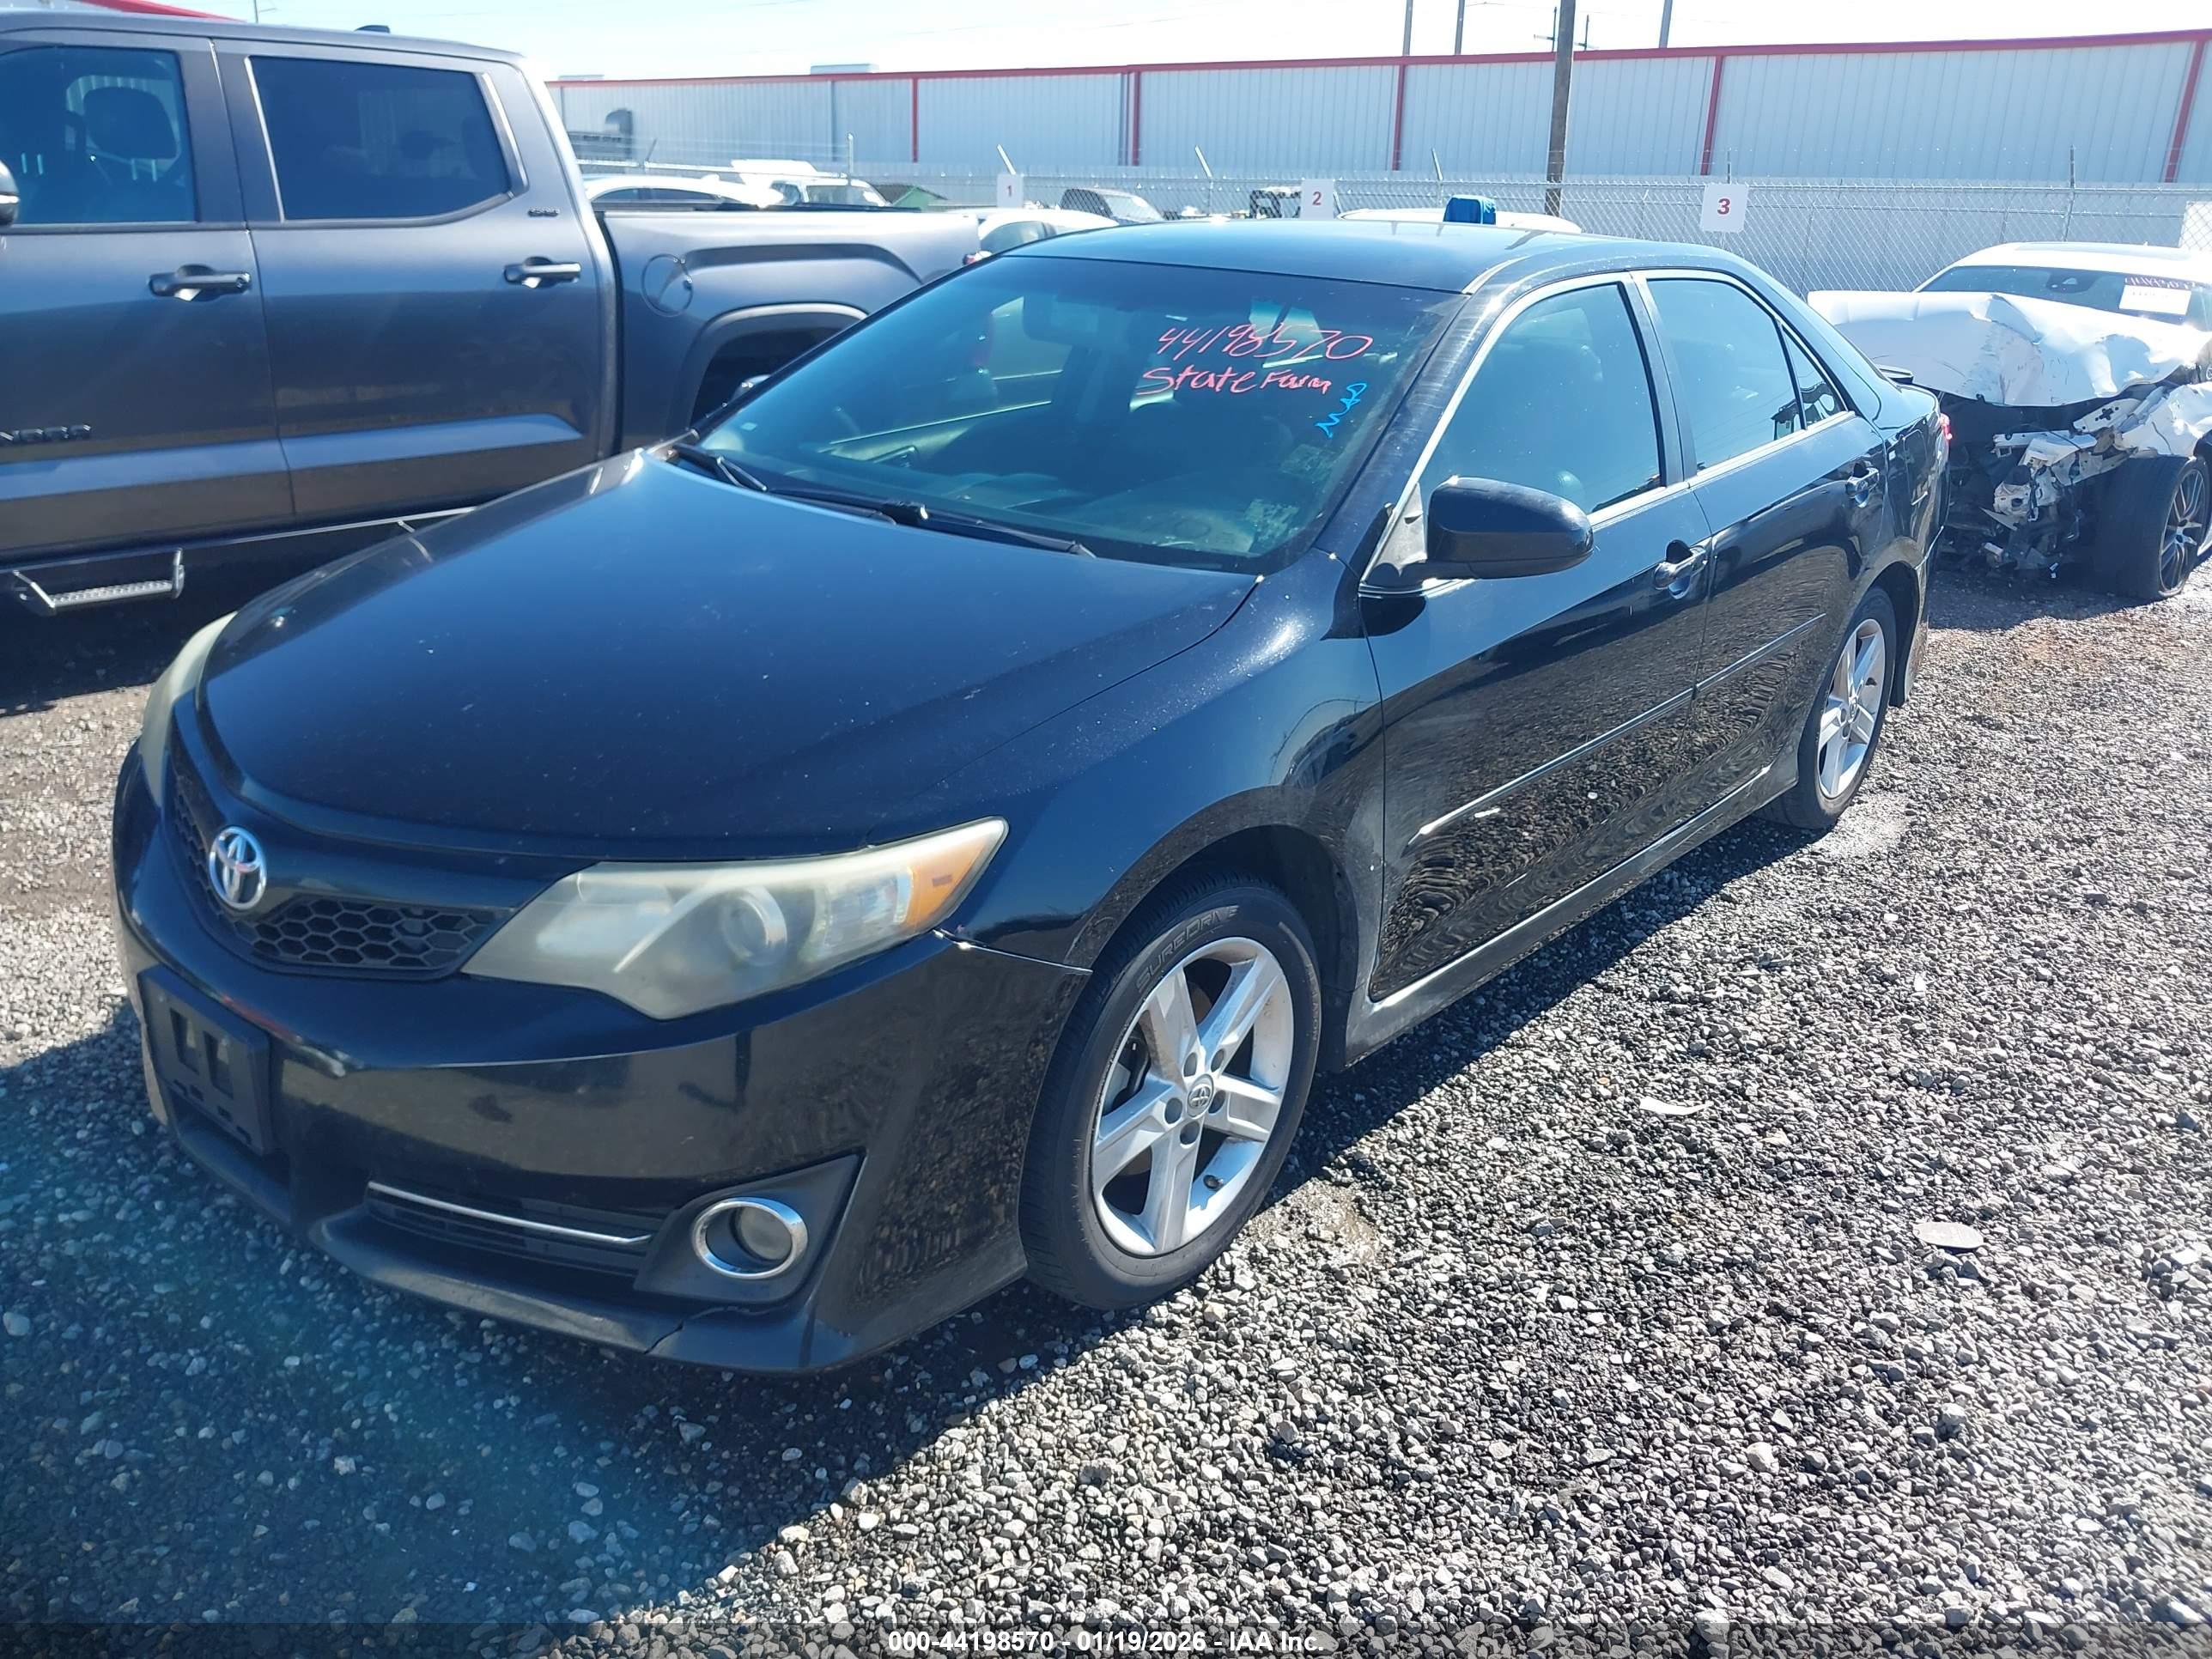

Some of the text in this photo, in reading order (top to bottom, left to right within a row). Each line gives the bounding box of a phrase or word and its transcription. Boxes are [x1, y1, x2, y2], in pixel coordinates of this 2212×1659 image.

[1006, 185, 1012, 198] 1
[1312, 191, 1322, 206] 2
[1717, 198, 1731, 215] 3
[1157, 322, 1373, 360] 44198570
[1135, 364, 1257, 395] State
